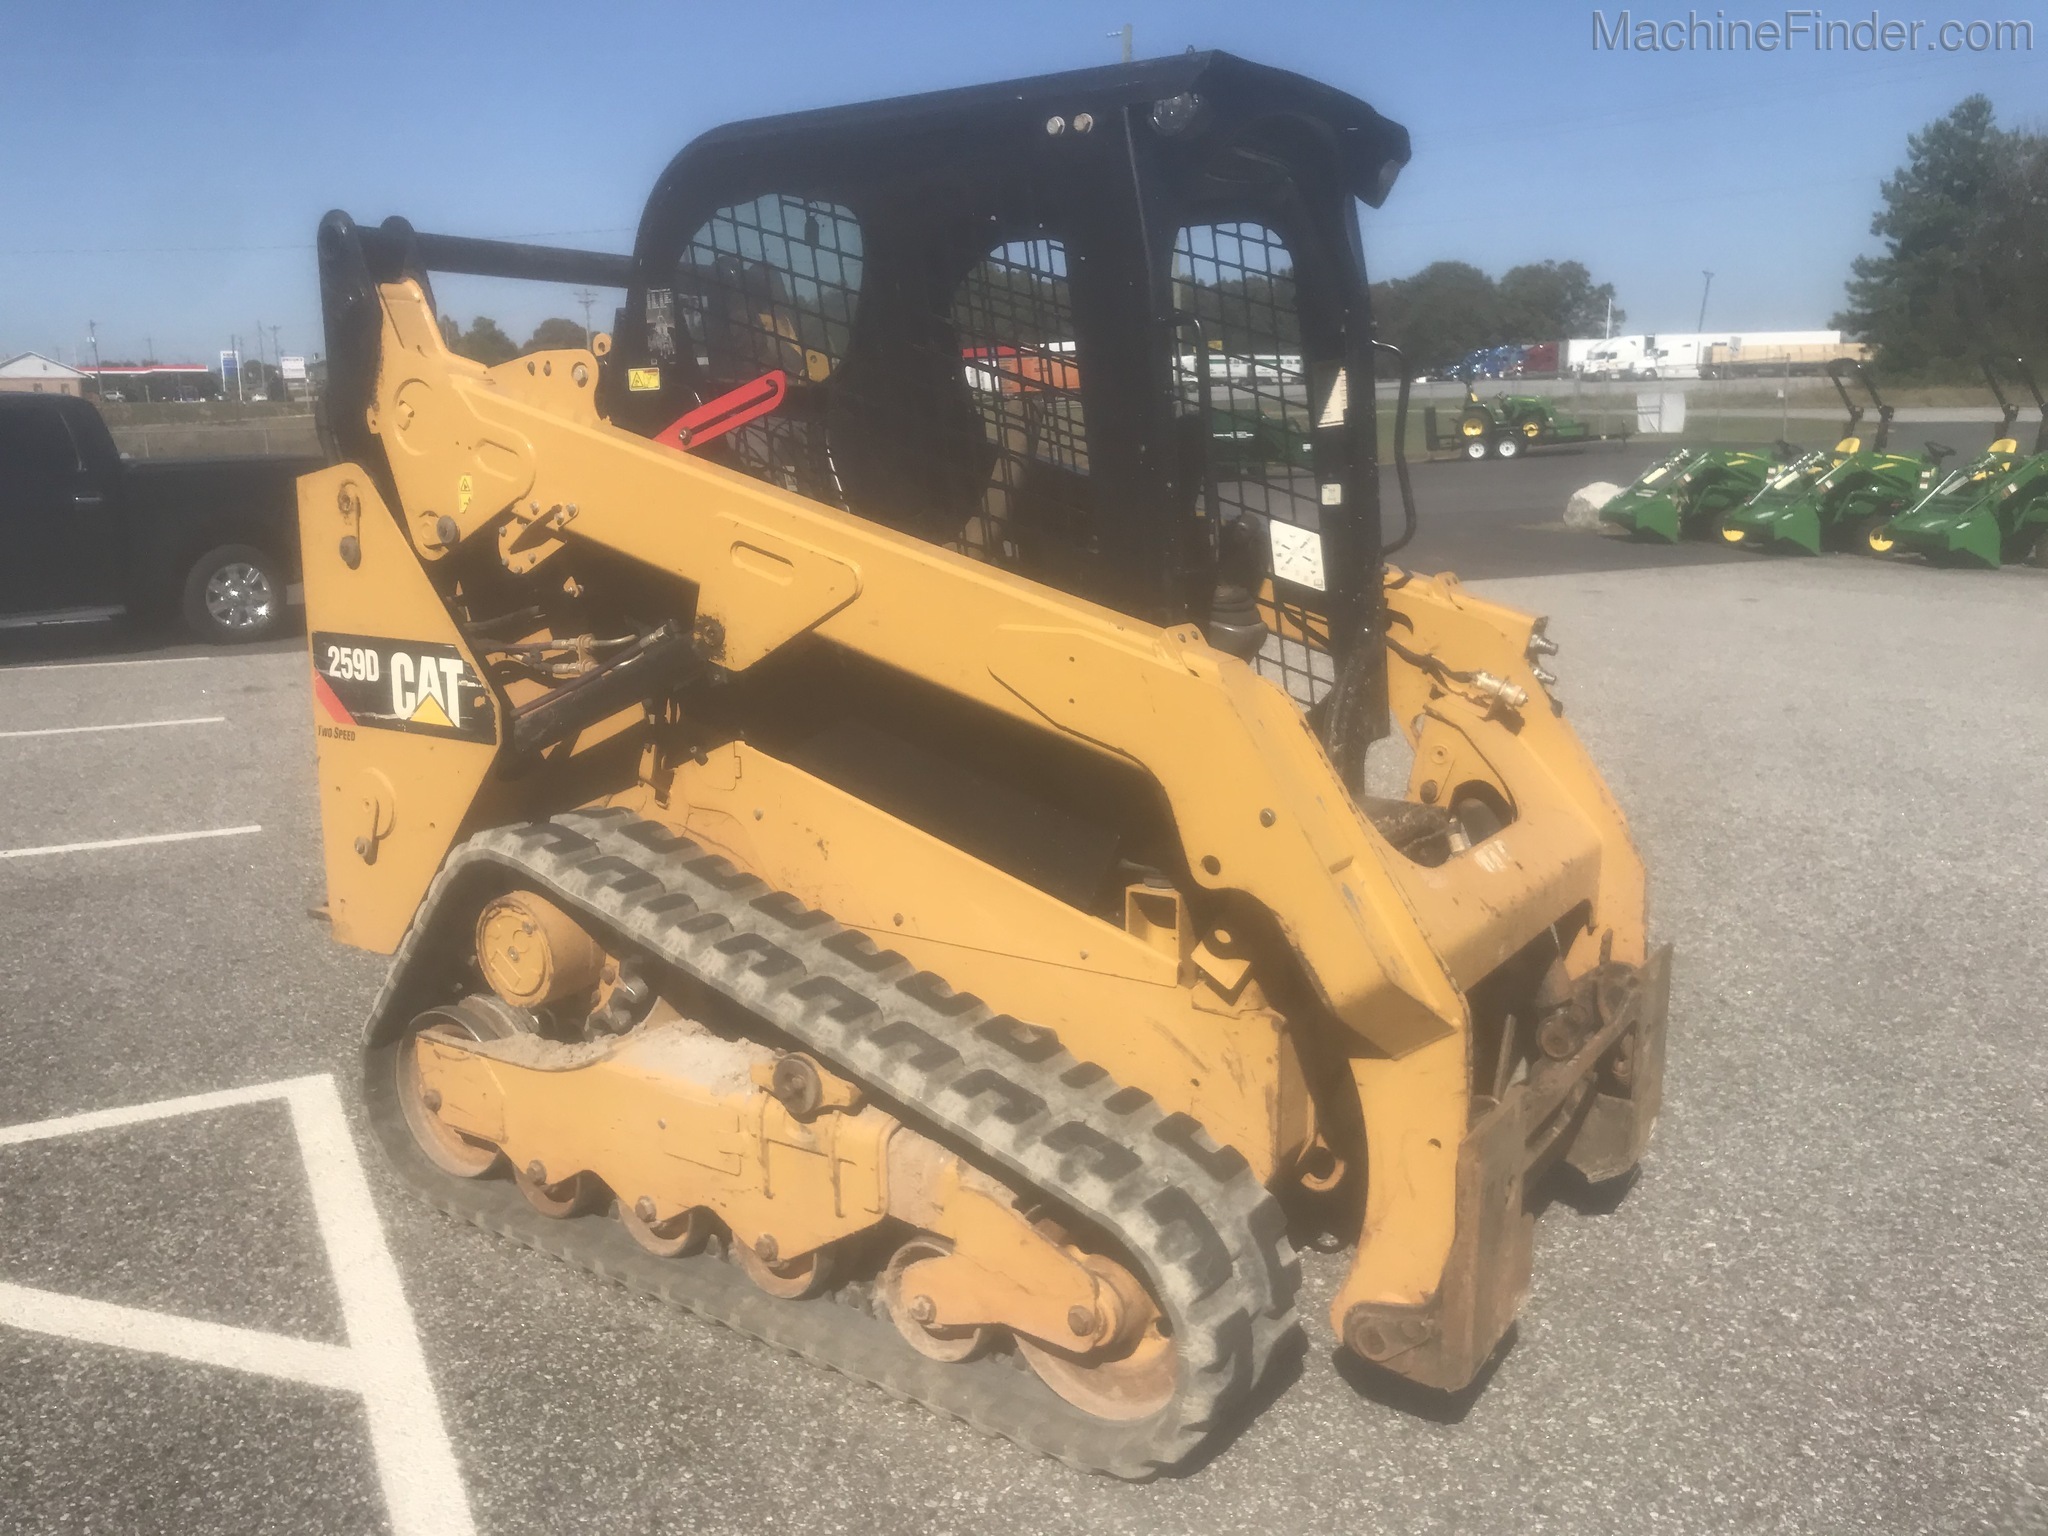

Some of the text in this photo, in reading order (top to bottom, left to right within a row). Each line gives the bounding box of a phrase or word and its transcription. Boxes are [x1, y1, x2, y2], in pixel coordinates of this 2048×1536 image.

[328, 645, 464, 728] 259D CAT
[333, 726, 356, 741] SPEED
